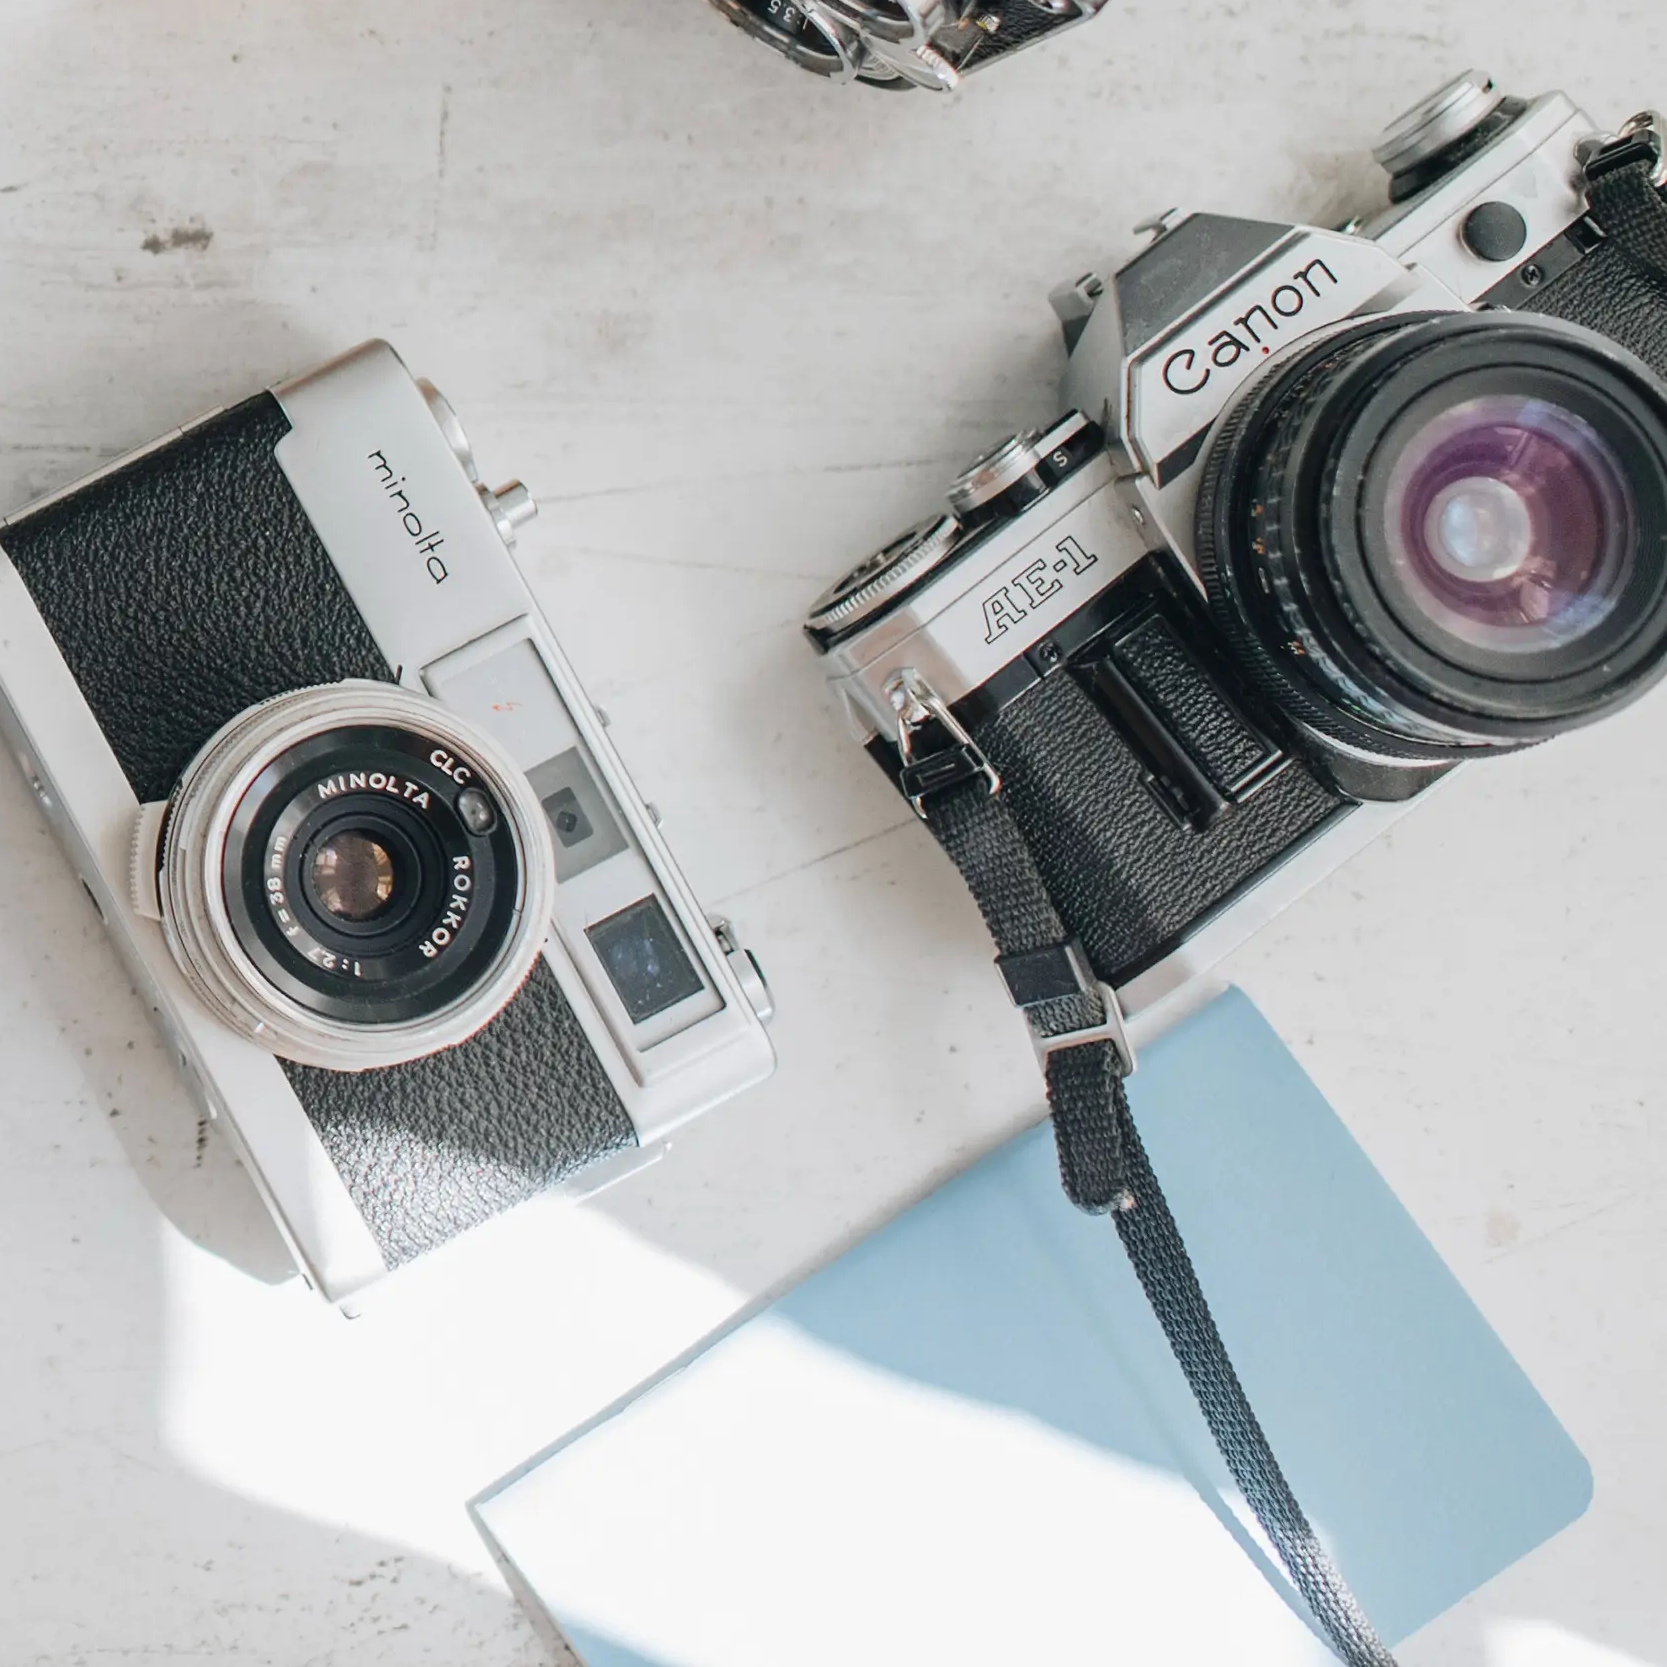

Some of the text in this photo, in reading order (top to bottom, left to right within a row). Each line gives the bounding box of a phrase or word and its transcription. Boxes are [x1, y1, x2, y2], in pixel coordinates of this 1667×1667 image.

[1161, 258, 1339, 396] Canon
[367, 449, 449, 585] minolta
[979, 535, 1099, 645] AE-1
[429, 748, 472, 785] CLC
[317, 771, 431, 810] MINOLTA
[418, 854, 472, 959] ROKKOR
